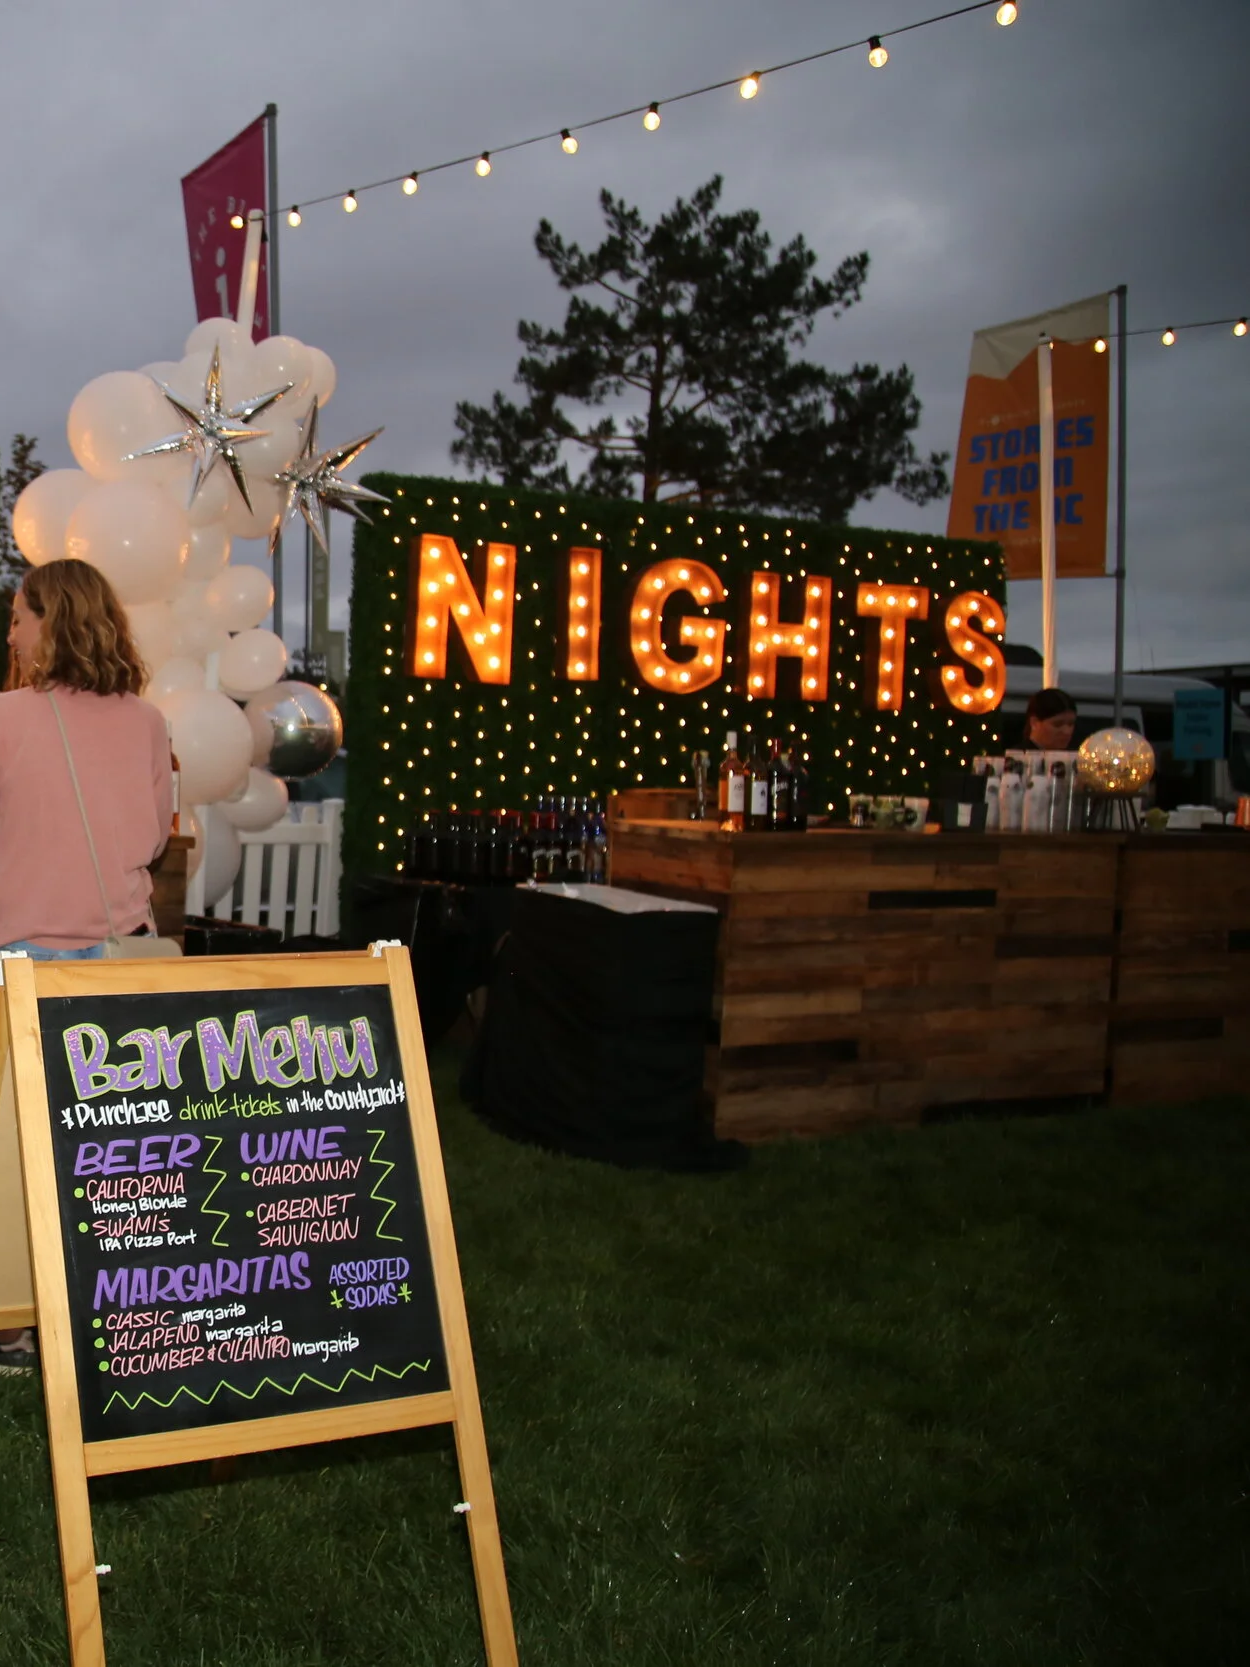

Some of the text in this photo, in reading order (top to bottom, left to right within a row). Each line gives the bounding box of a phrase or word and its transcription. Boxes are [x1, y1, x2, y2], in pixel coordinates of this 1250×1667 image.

[969, 416, 1095, 463] STORES
[973, 500, 1030, 534] THE
[406, 532, 1008, 716] NIGHTS
[62, 1010, 379, 1100] Bar Menu
[179, 1094, 228, 1121] drink
[229, 1092, 283, 1119] tickets
[286, 1096, 300, 1113] in
[300, 1089, 324, 1113] the
[73, 1133, 201, 1176] BEER
[240, 1125, 347, 1165] WINE
[86, 1172, 185, 1202] CALIFORNIA
[252, 1156, 363, 1188] CHARDONNAY
[92, 1194, 188, 1218] Honey Blonde
[257, 1193, 357, 1225] CABERNET
[100, 1228, 197, 1252] IPA Pizza Port
[257, 1215, 360, 1248] SAUVIGNON
[93, 1251, 312, 1310] MARGARITAS
[329, 1256, 410, 1286] ASSORTED
[105, 1302, 246, 1330] CLASSIC margarita
[205, 1315, 283, 1342] margarita
[110, 1346, 205, 1377] CUCUMBER
[218, 1334, 290, 1363] CILANTRO
[292, 1331, 360, 1363] margarita
